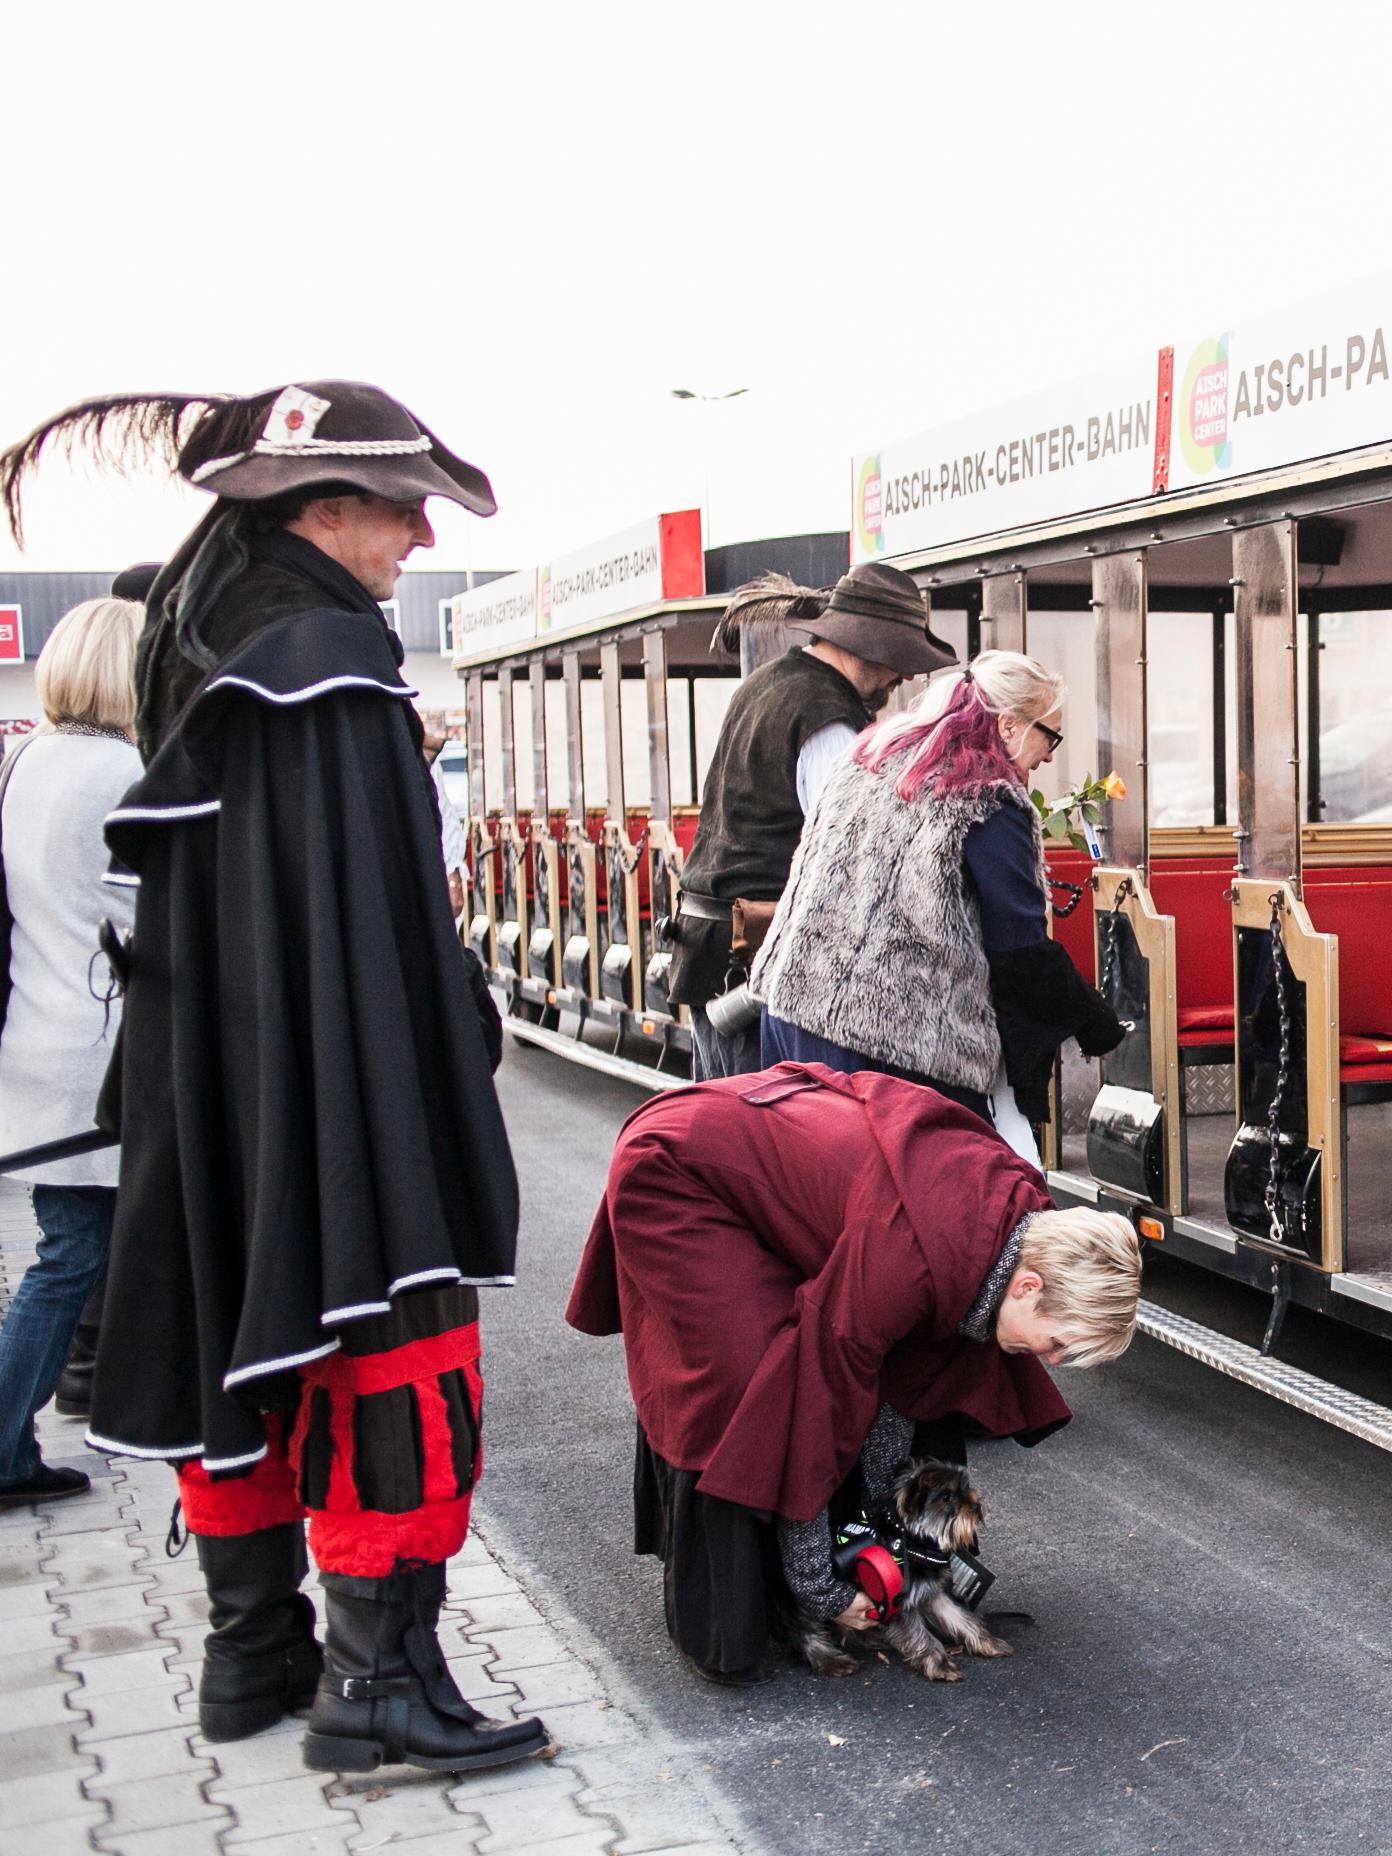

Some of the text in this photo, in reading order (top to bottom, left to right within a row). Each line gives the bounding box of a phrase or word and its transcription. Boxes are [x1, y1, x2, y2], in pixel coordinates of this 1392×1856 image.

[1196, 369, 1227, 397] AISCH
[1194, 391, 1227, 422] PARK
[1194, 418, 1226, 440] CENTER
[884, 400, 1151, 518] AISCH-PARK-CENTER-BAHN
